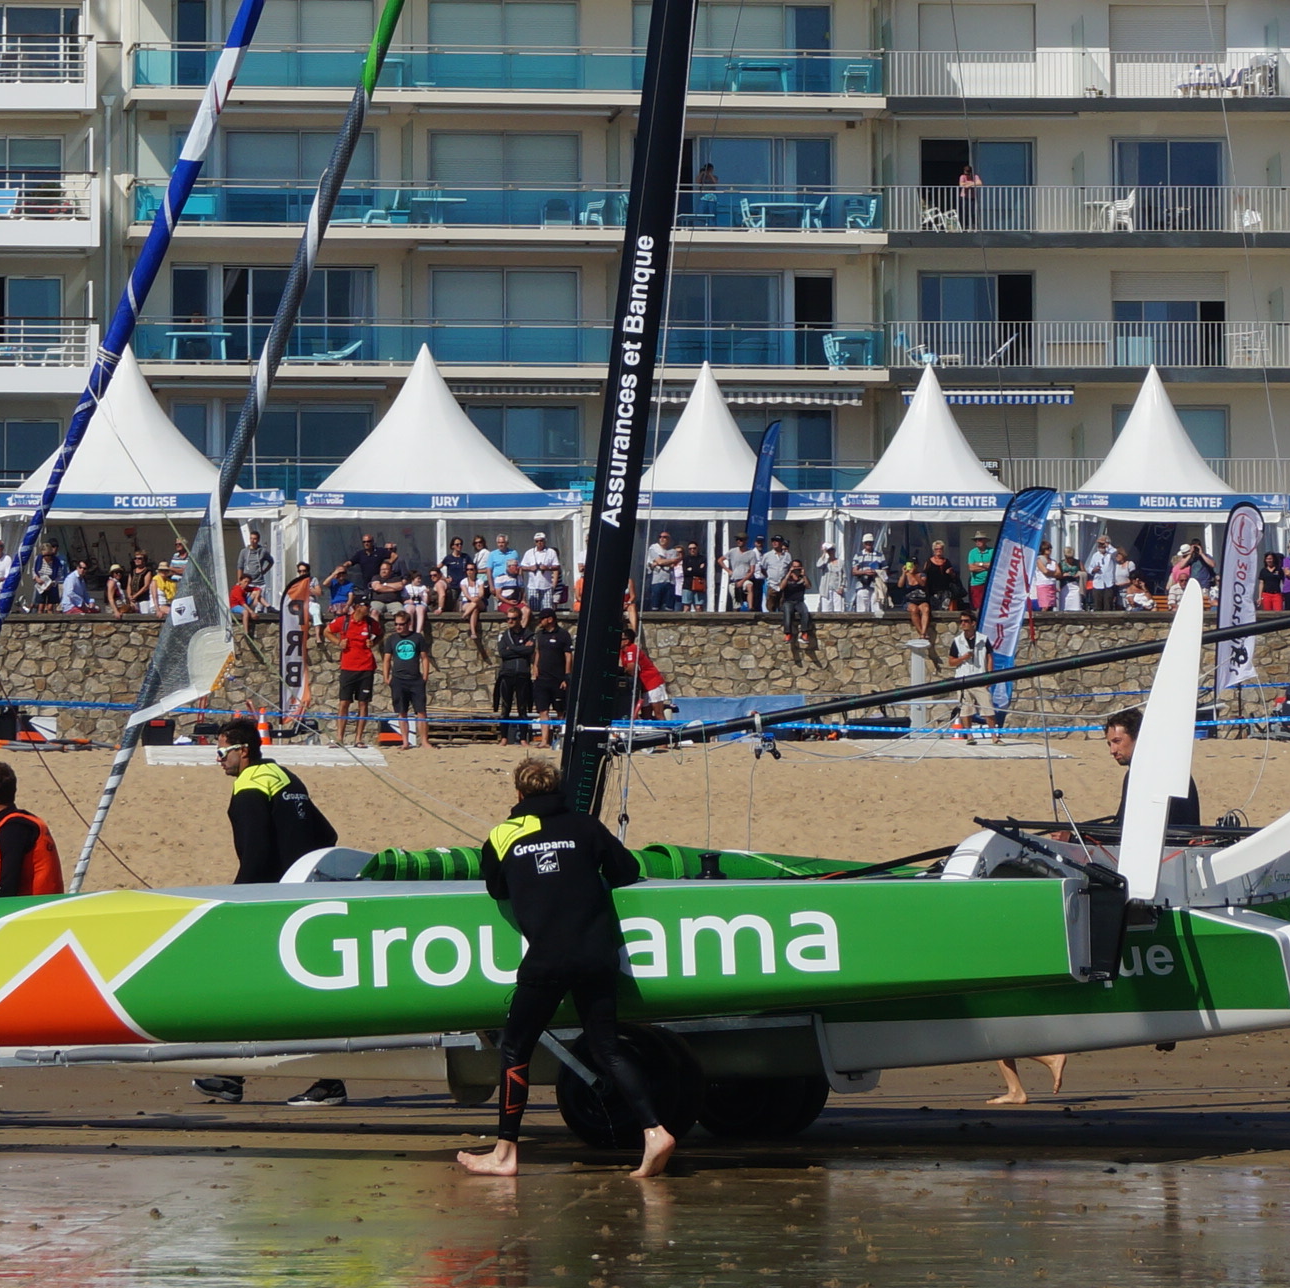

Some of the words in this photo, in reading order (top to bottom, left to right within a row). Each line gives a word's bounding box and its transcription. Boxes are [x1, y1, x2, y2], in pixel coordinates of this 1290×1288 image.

[622, 234, 655, 334] Banque
[621, 341, 642, 366] et
[600, 374, 638, 528] Assurances
[114, 495, 130, 507] PC
[132, 495, 177, 507] COURSE
[431, 495, 459, 508] JURY
[910, 495, 949, 506] MEDIA
[951, 496, 997, 507] CENTER
[1140, 496, 1178, 507] MEDIA
[999, 546, 1025, 619] YANMAR
[513, 840, 576, 856] Groupama
[278, 899, 841, 990] Grouama
